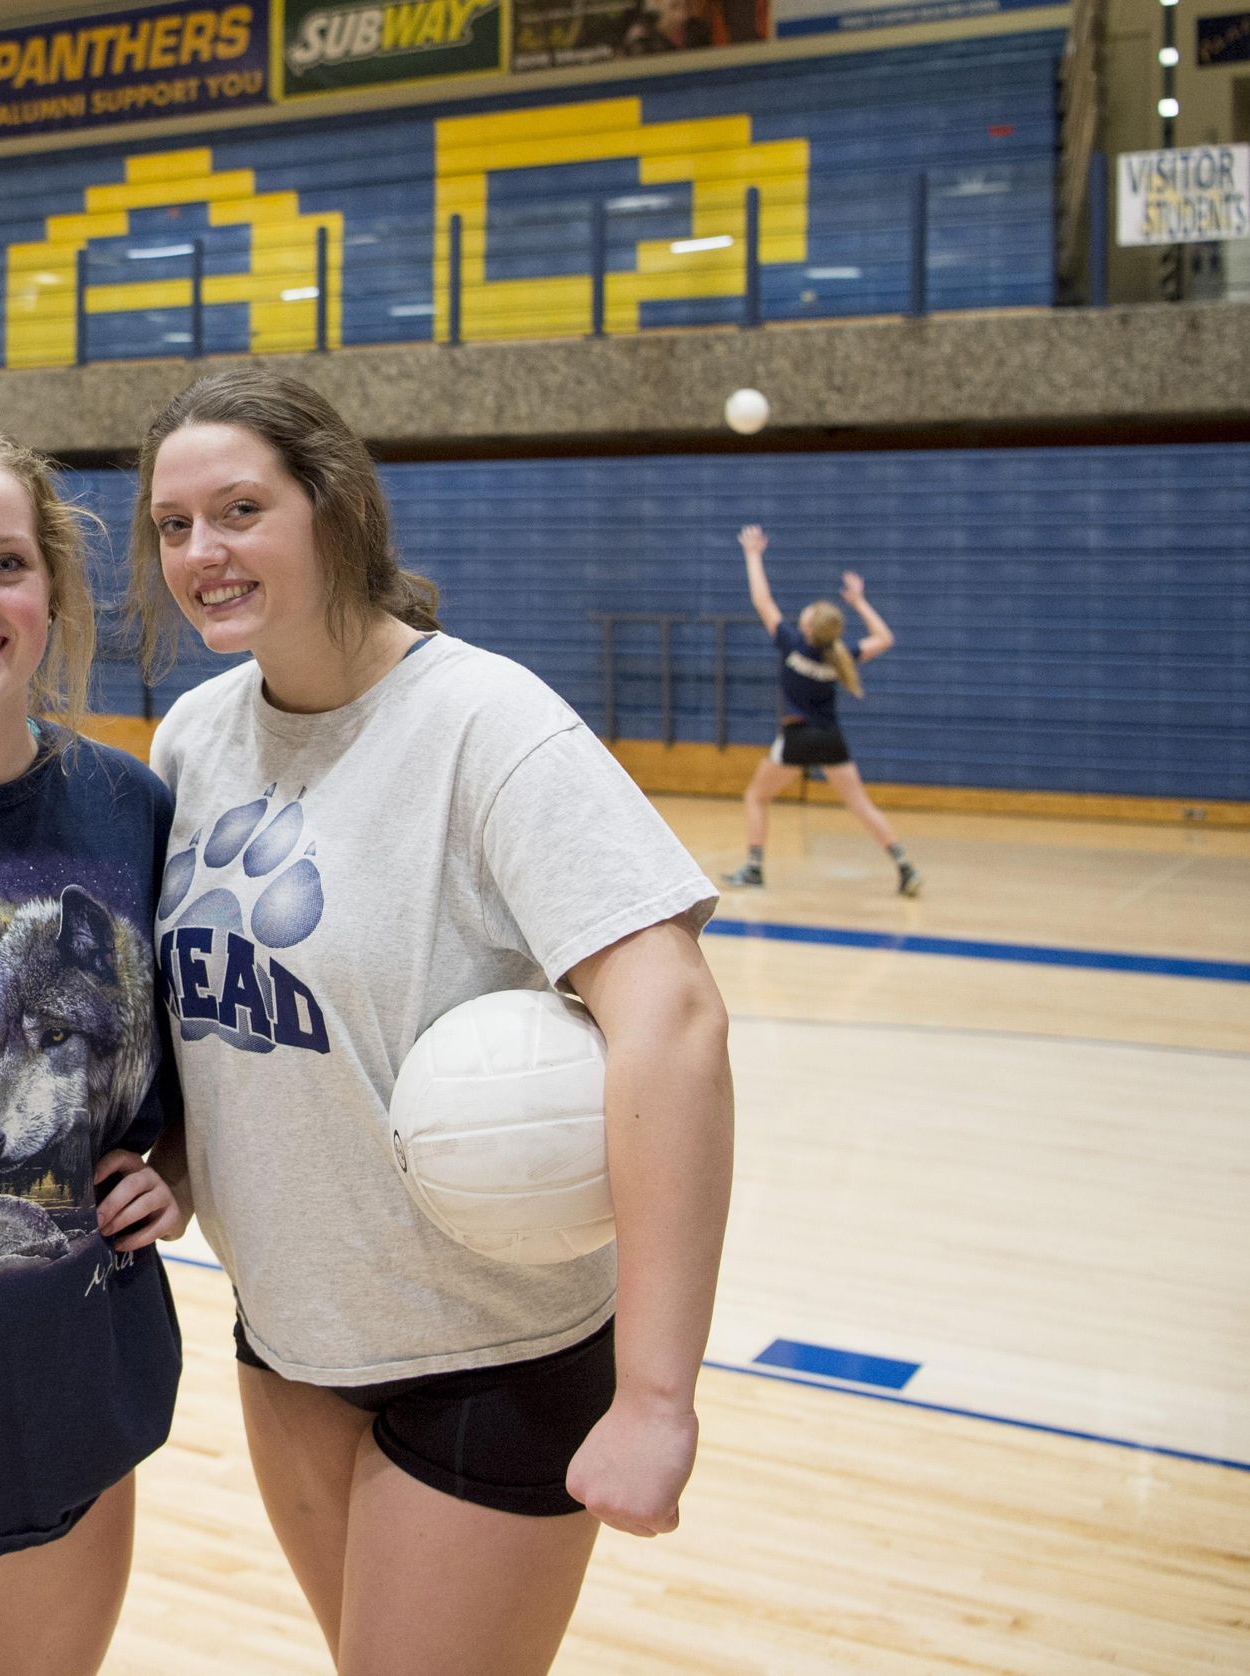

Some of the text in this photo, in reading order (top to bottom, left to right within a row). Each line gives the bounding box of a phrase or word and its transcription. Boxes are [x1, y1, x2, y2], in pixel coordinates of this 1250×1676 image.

[291, 0, 491, 63] SUBWAY
[91, 78, 200, 114] SUPPORT
[206, 70, 263, 98] YOU
[1127, 150, 1235, 194] VISITOR
[1142, 192, 1247, 240] STUDENTS
